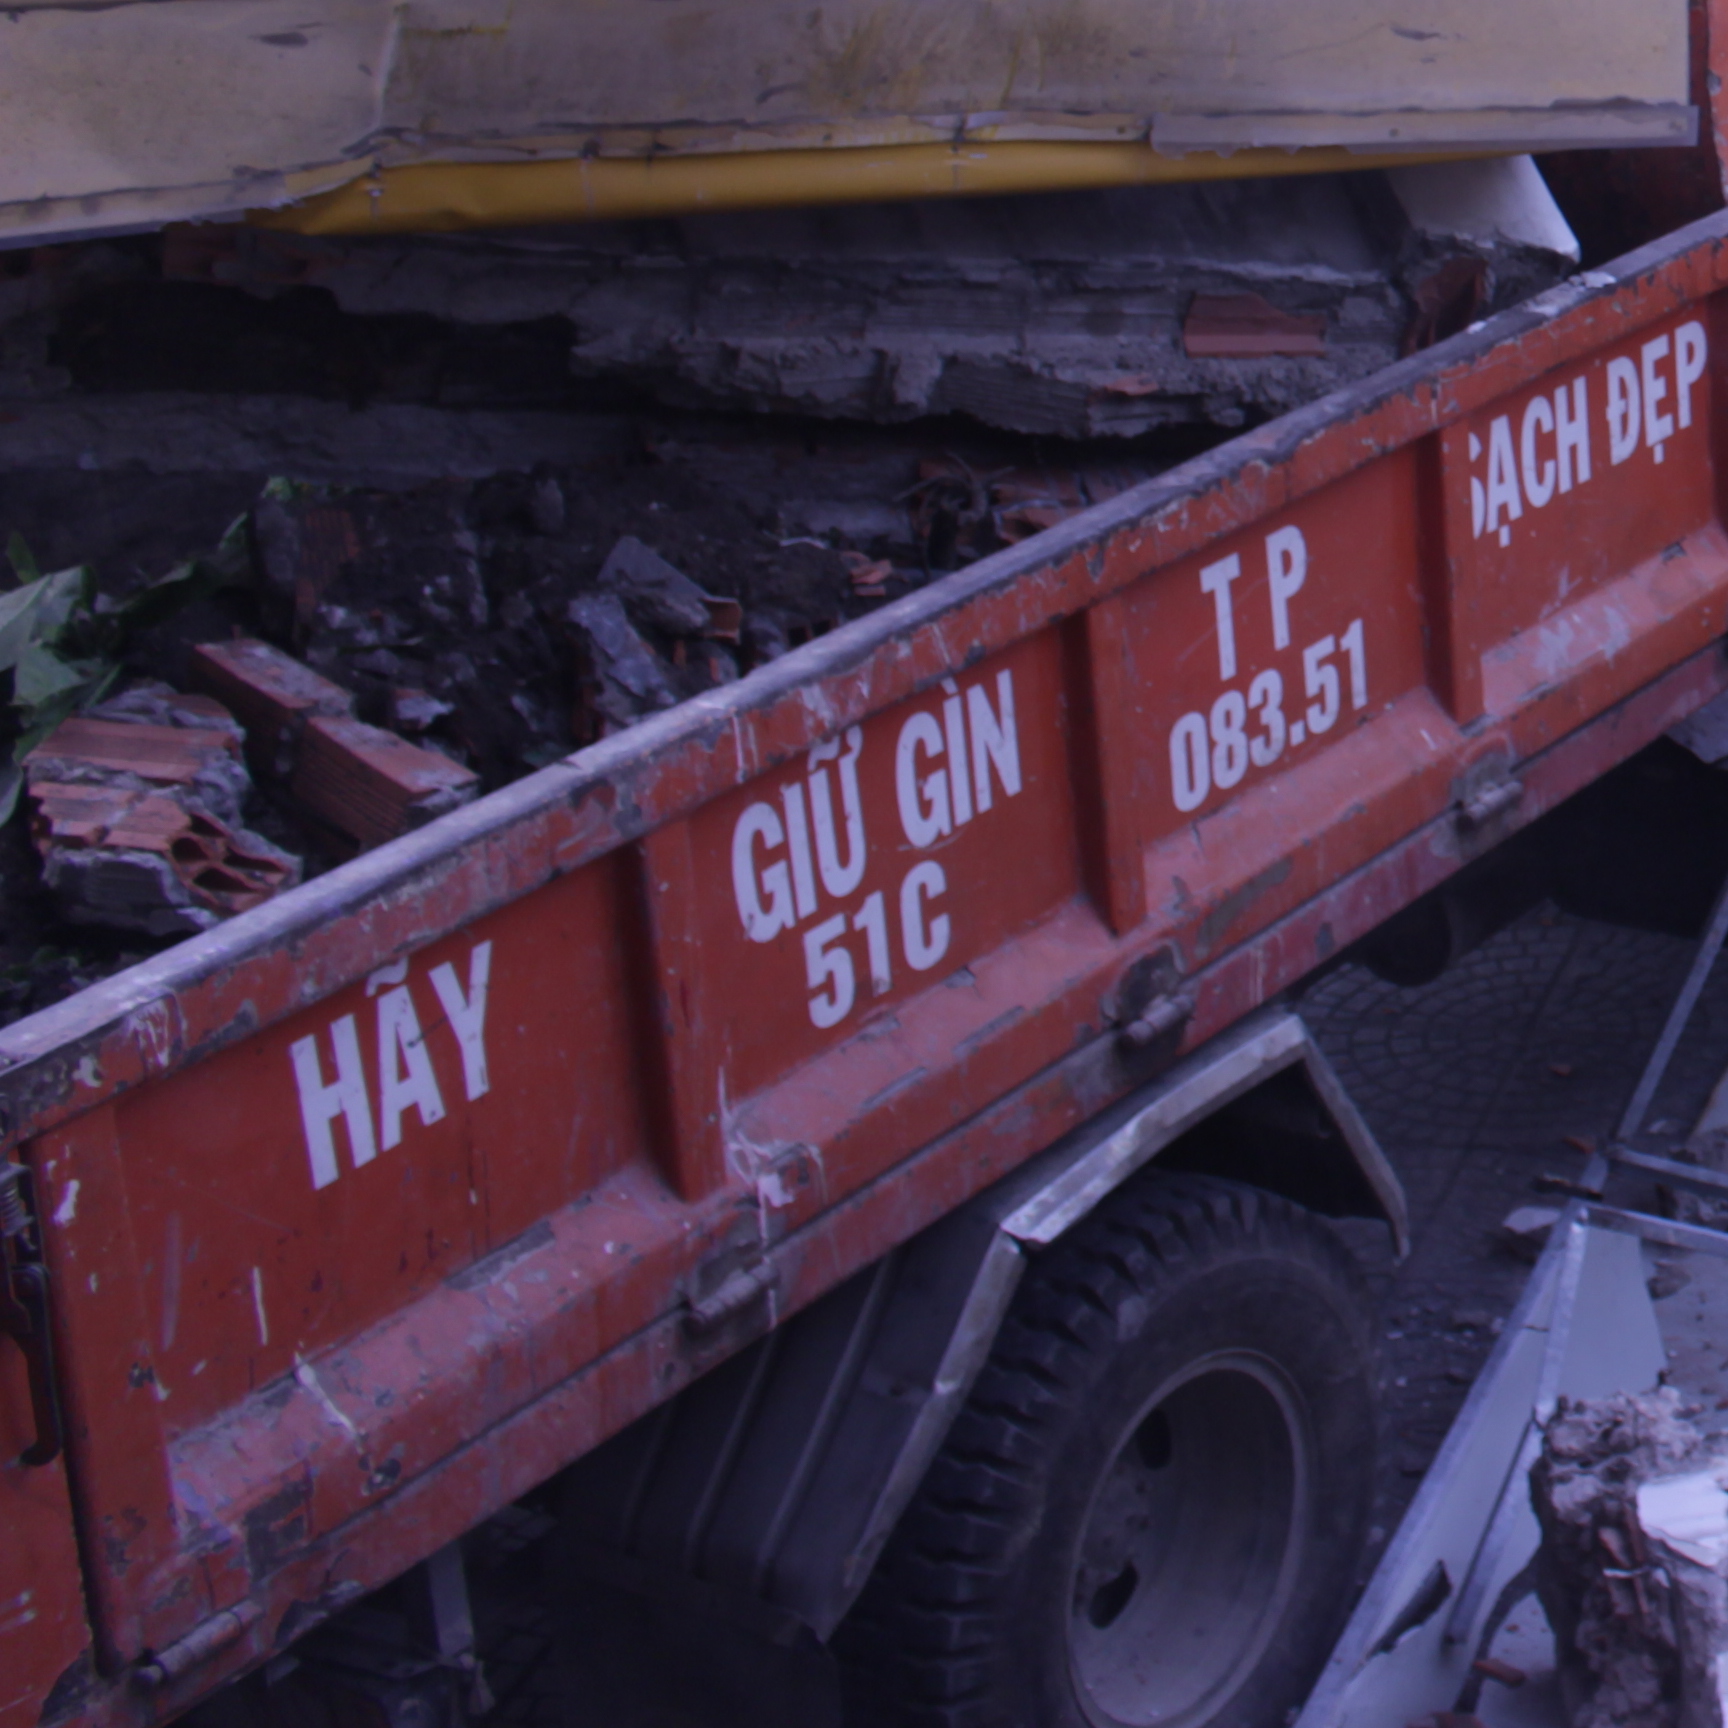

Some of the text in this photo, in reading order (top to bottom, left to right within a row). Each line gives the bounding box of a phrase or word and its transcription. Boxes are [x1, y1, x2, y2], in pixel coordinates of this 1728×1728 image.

[290, 939, 493, 1190] HÃY
[730, 727, 868, 943] GIỮ
[894, 669, 1023, 849] GÌN
[1605, 320, 1709, 465] ĐẸP
[1169, 617, 1368, 812] 083.51
